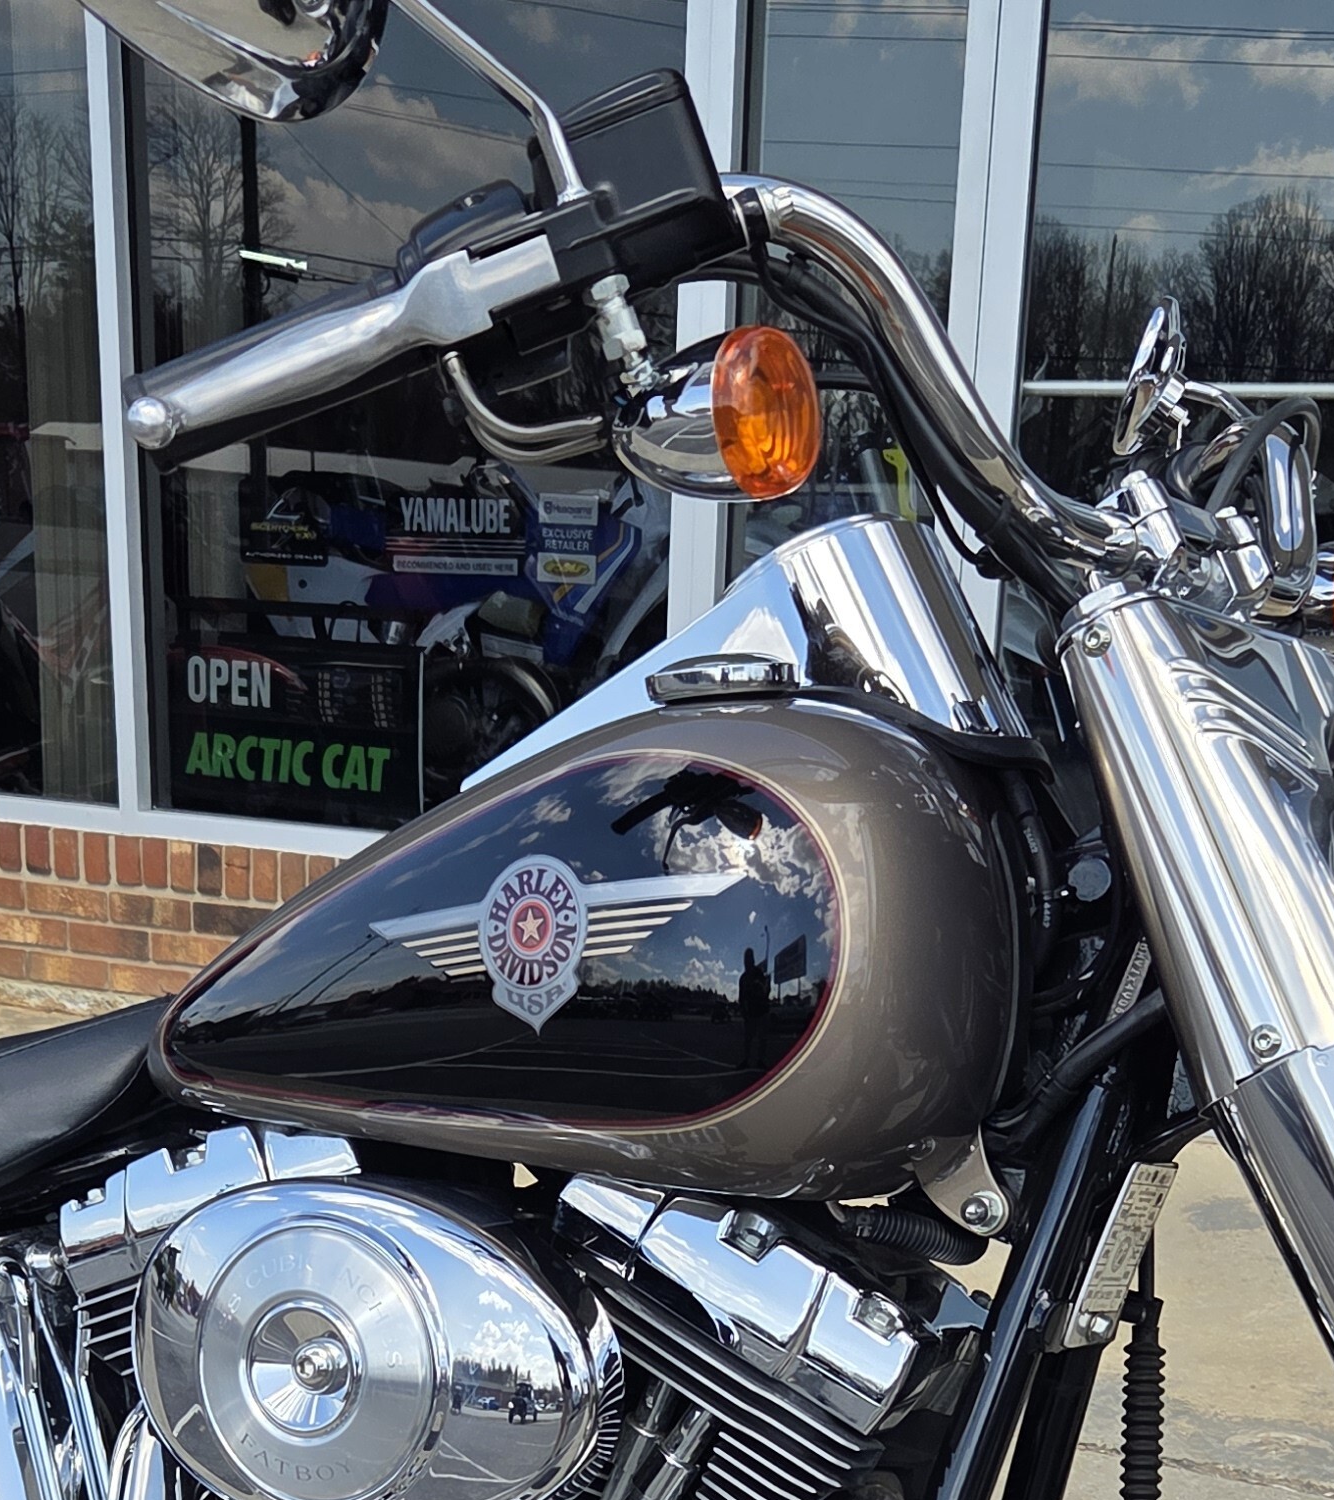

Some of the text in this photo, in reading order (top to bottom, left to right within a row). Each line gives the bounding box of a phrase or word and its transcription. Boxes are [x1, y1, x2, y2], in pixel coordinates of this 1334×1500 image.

[399, 496, 512, 534] YAMALUBE
[541, 527, 594, 541] EXCLUSIVE
[396, 559, 514, 573] RECOMMENDED AND USED HERE
[544, 539, 590, 552] RETAILER
[187, 655, 272, 708] OPEN
[185, 731, 391, 793] ARCTIC CAT
[488, 868, 578, 922] HARLEY
[487, 923, 578, 986] DAVIDSON
[506, 983, 566, 1016] USA
[240, 1432, 352, 1482] FATBOY
